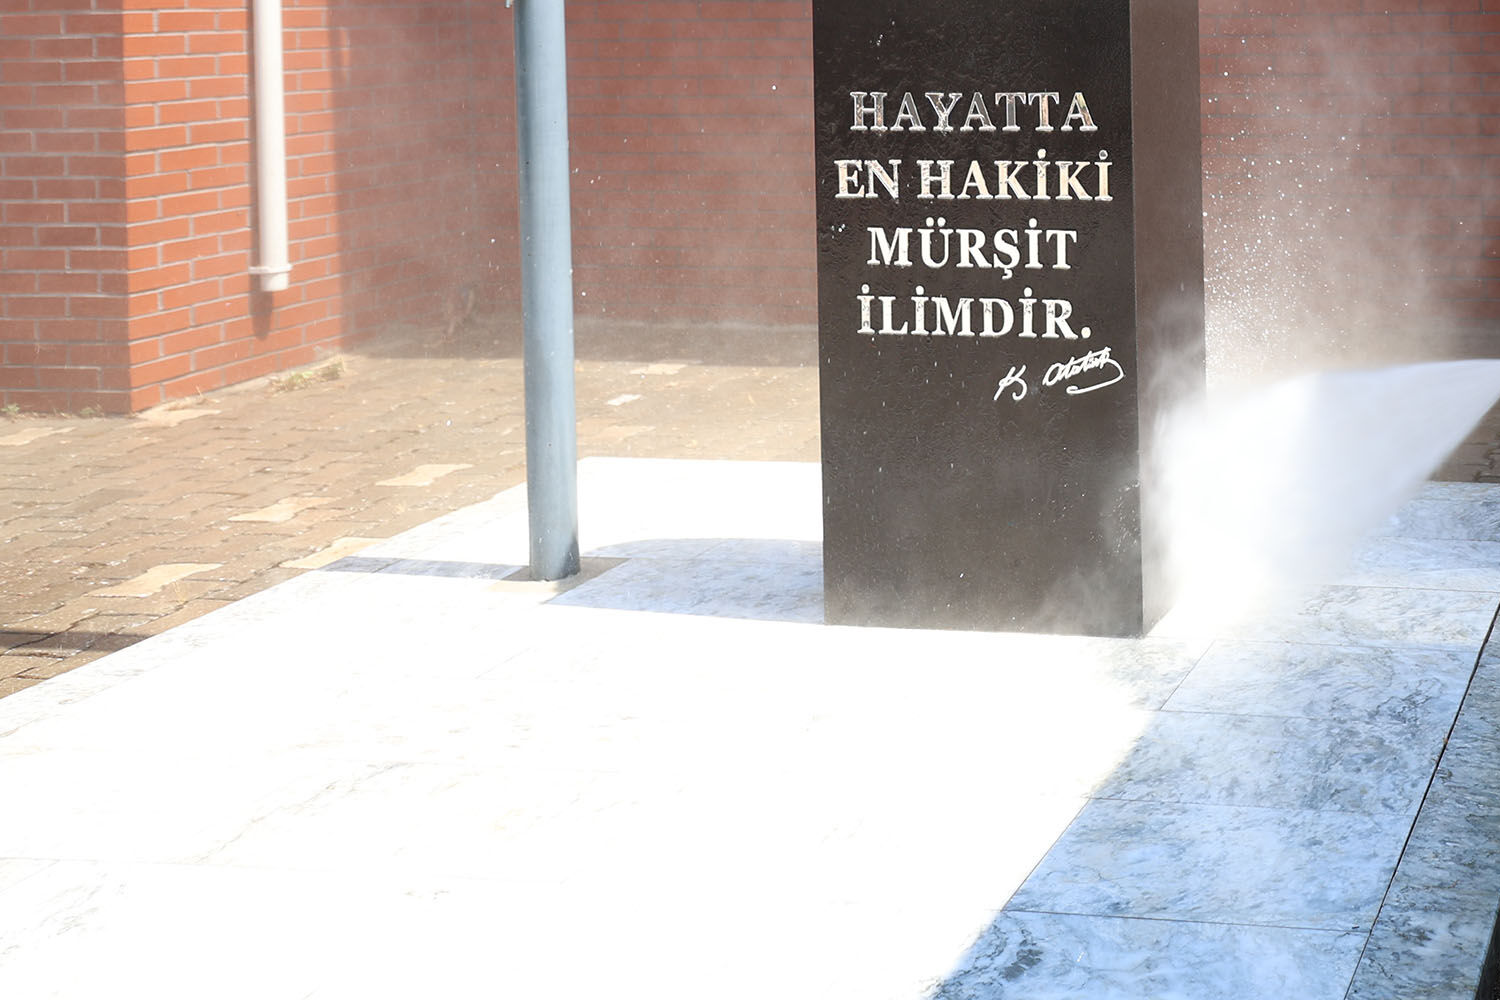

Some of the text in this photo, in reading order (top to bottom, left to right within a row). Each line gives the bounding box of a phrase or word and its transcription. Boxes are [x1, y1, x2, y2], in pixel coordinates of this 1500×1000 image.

[849, 91, 1099, 132] HAYATTA
[834, 148, 1114, 202] EN HAKİKİ
[866, 216, 1078, 280] MÜRŞİT
[856, 283, 1092, 340] İLİMDİR.
